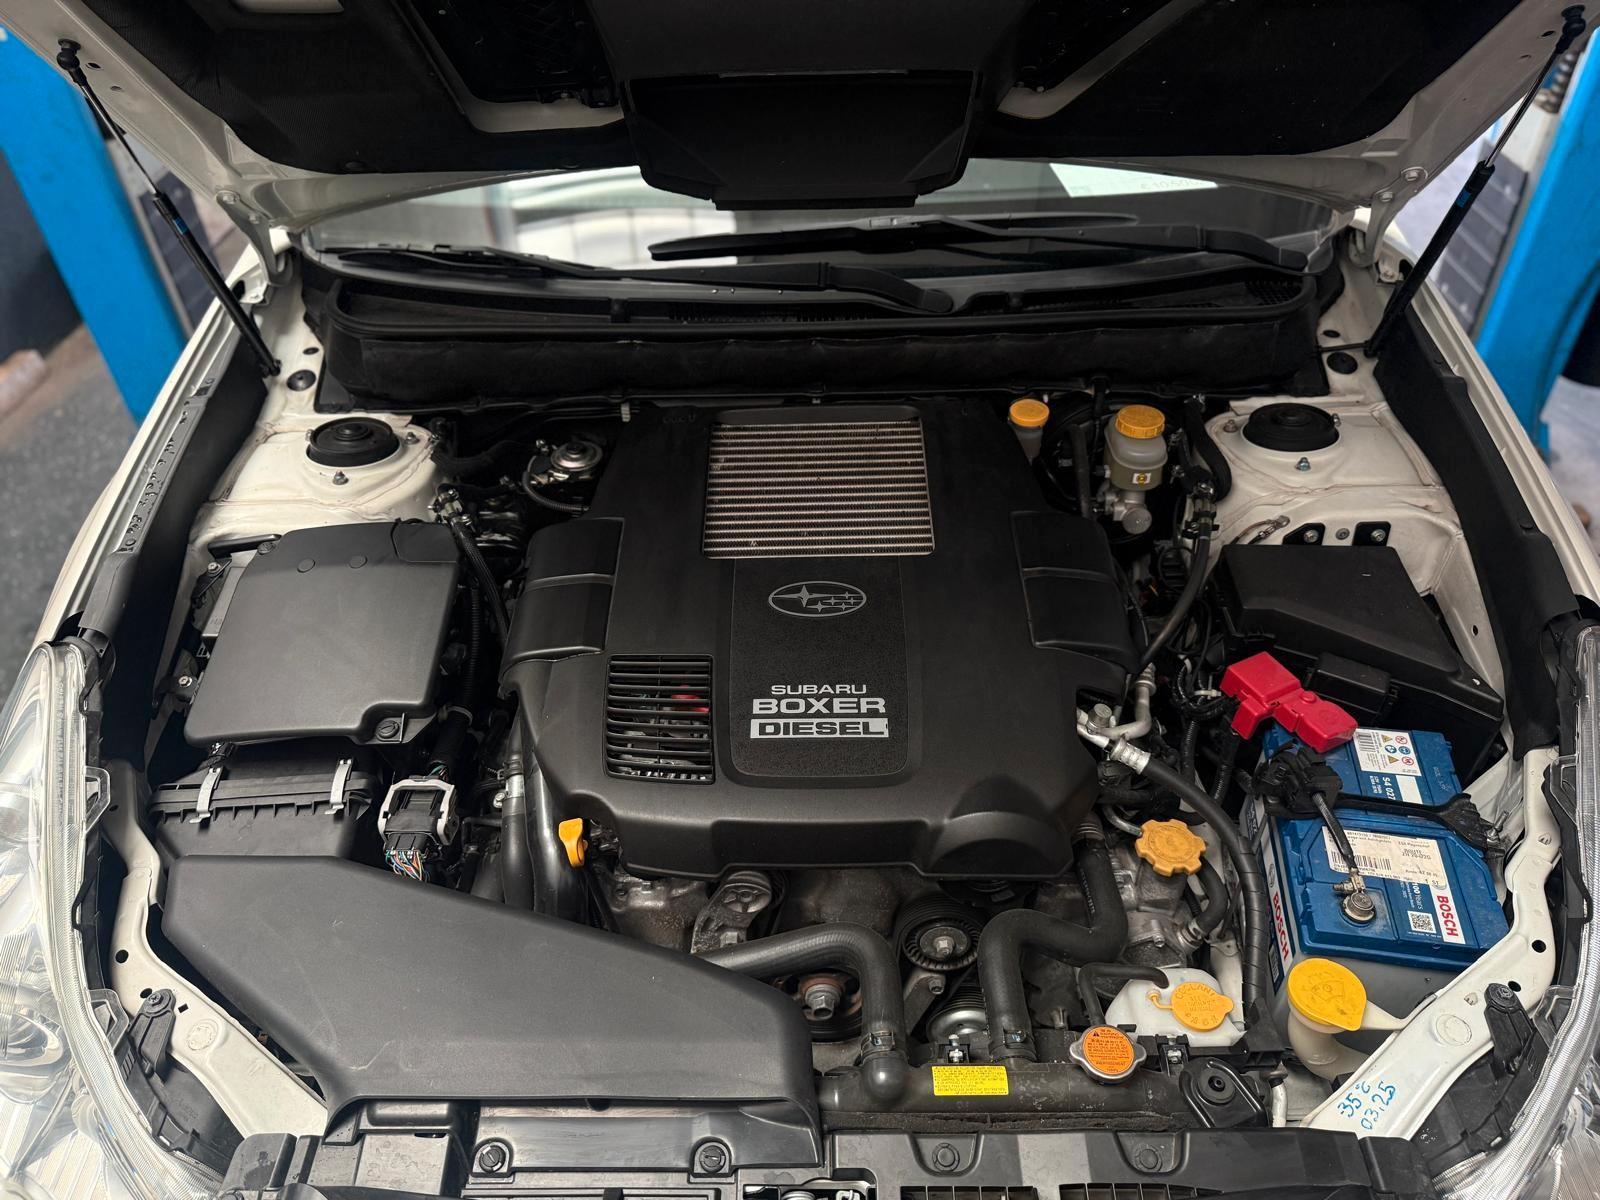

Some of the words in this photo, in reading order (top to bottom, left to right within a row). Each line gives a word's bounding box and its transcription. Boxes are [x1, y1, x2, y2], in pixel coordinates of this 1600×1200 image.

[771, 684, 867, 695] SUBARU
[752, 697, 886, 714] BOXER
[758, 721, 885, 736] DIESEL
[1382, 776, 1392, 787] S4
[1436, 895, 1459, 937] BOSCH
[1274, 891, 1290, 960] BOSCH
